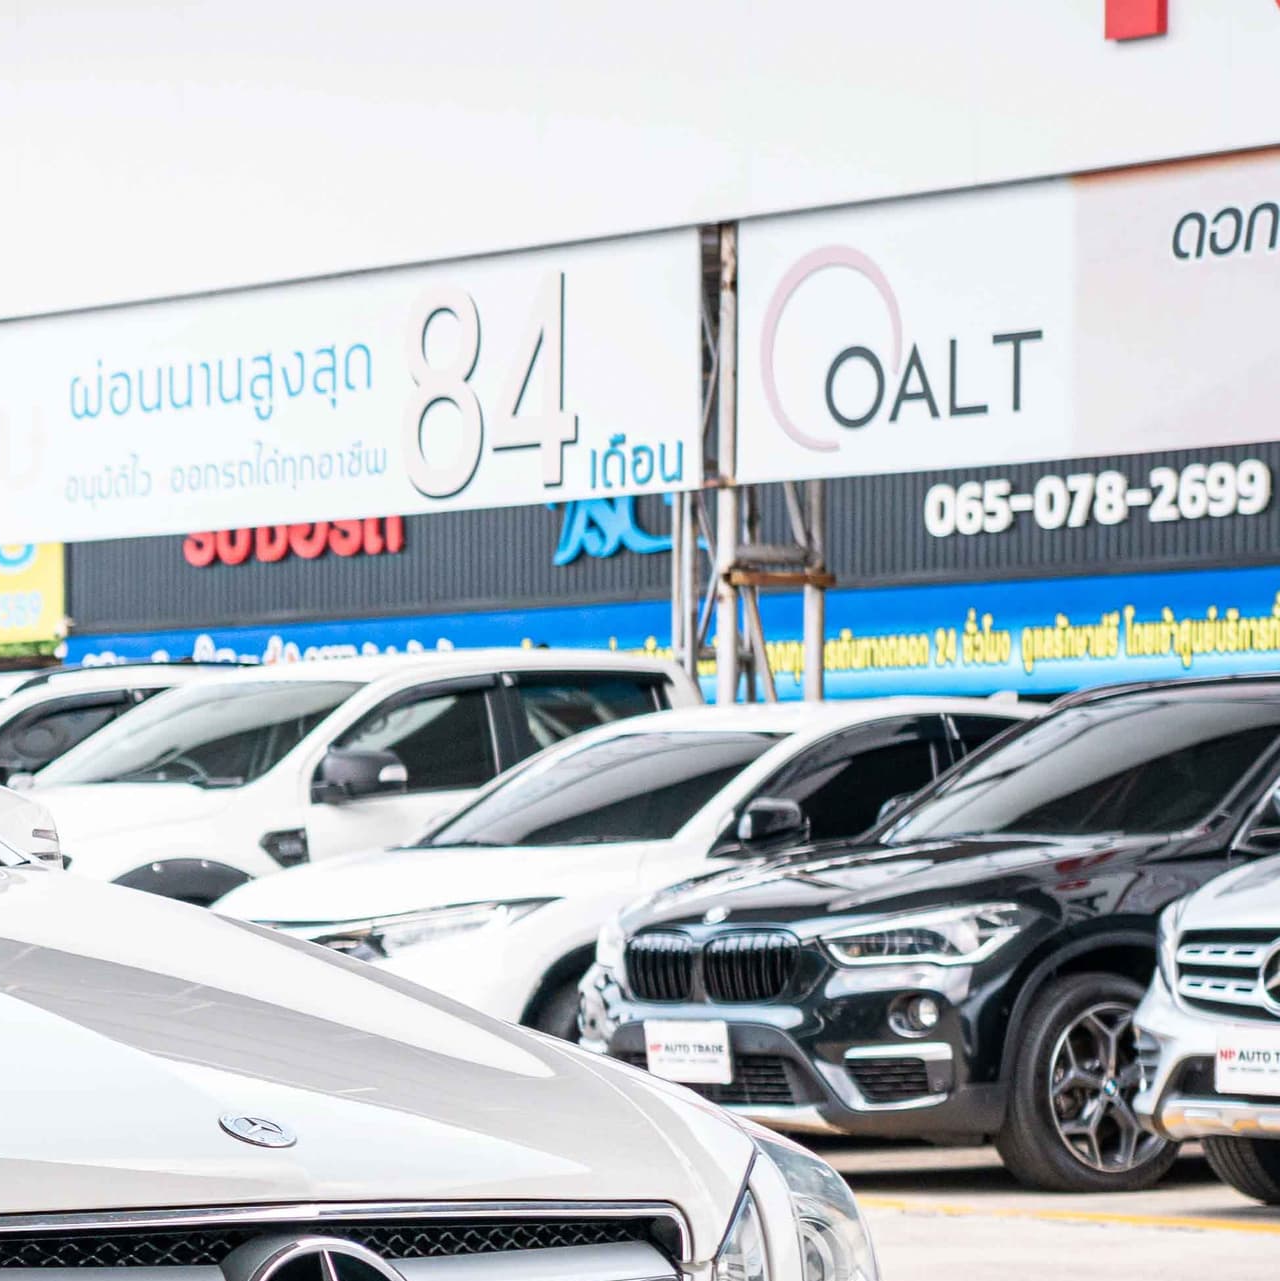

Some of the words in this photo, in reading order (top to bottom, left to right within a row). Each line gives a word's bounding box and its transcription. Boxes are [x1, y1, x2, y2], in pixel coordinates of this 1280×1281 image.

[68, 341, 373, 421] ผ่อนนานสูงสุด
[407, 270, 579, 500] 84
[590, 432, 684, 489] เดือน
[923, 458, 1272, 538] 065-078-2699
[1238, 1050, 1271, 1063] AUTO
